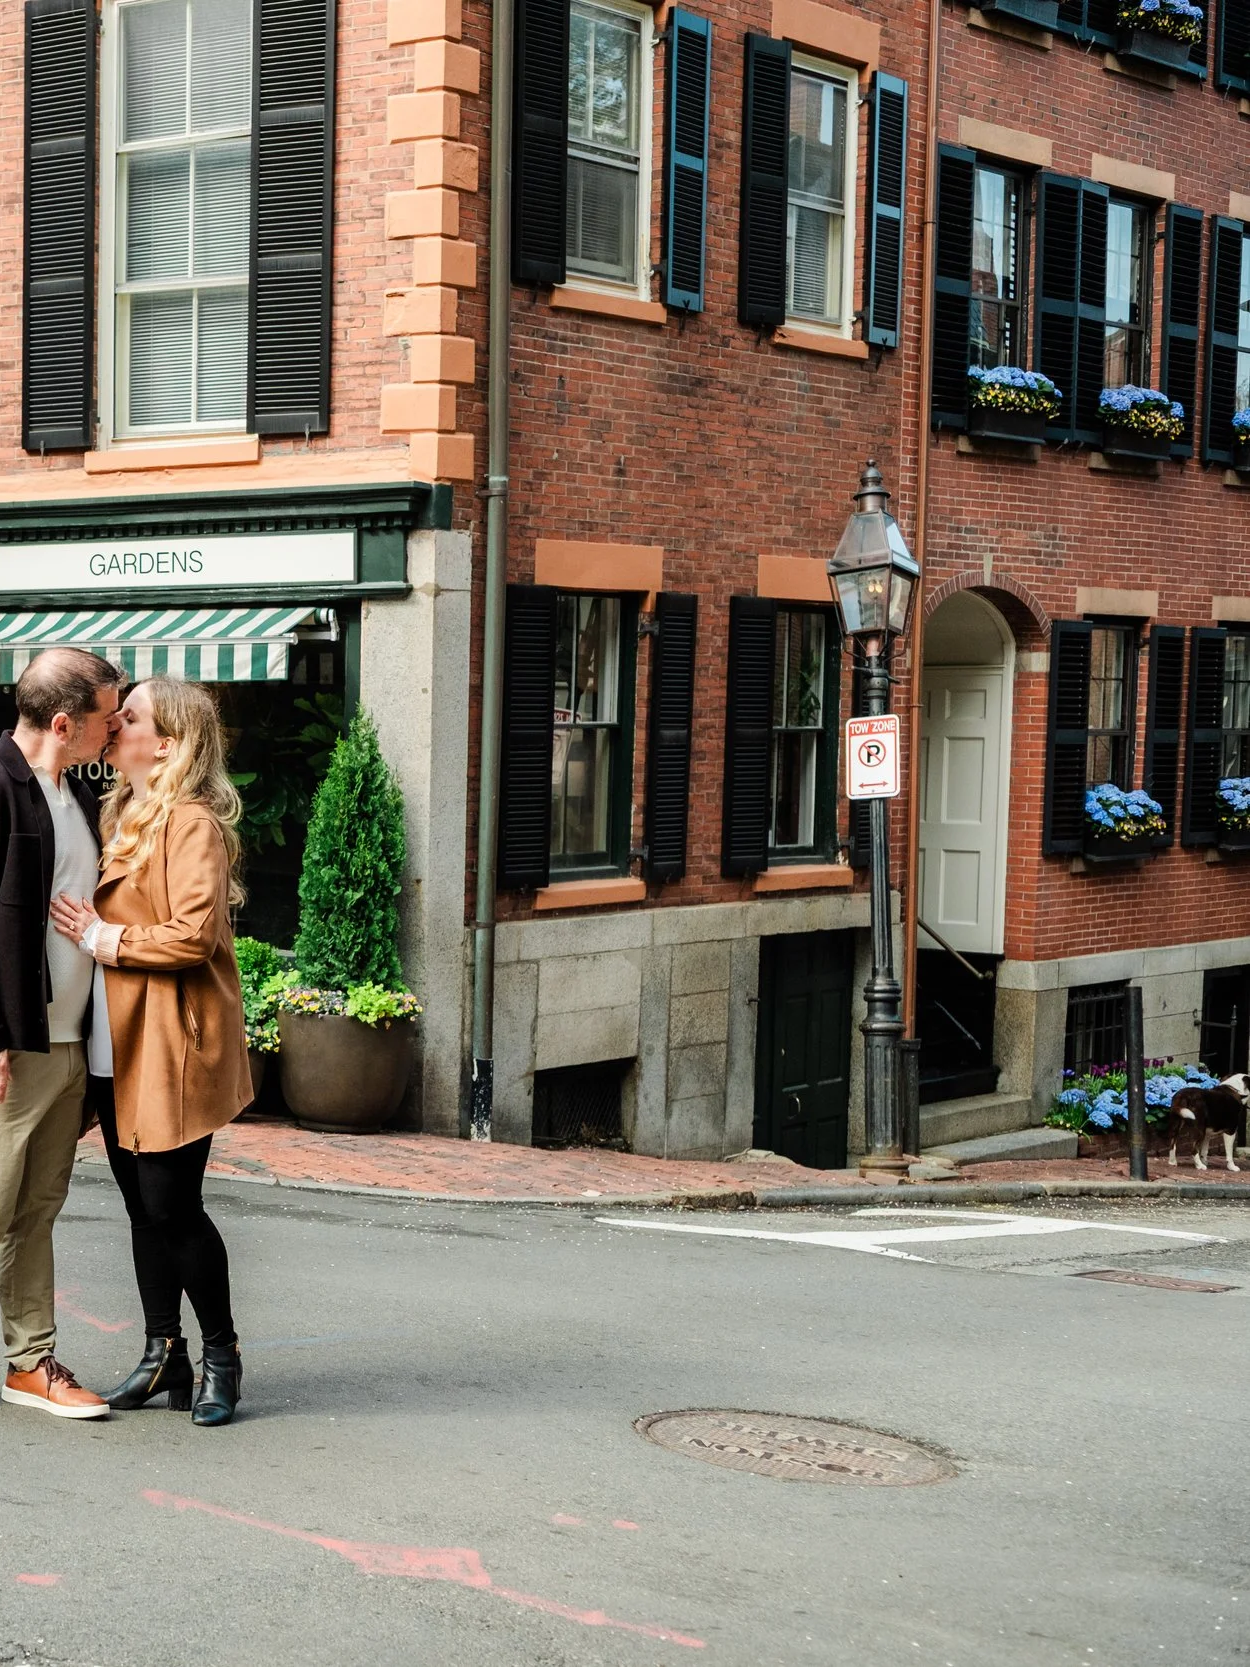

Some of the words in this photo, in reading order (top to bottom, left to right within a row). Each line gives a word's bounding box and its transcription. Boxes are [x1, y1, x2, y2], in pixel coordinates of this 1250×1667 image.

[90, 550, 203, 576] GARDENS
[850, 722, 869, 734] TOW
[871, 720, 895, 732] ZONE
